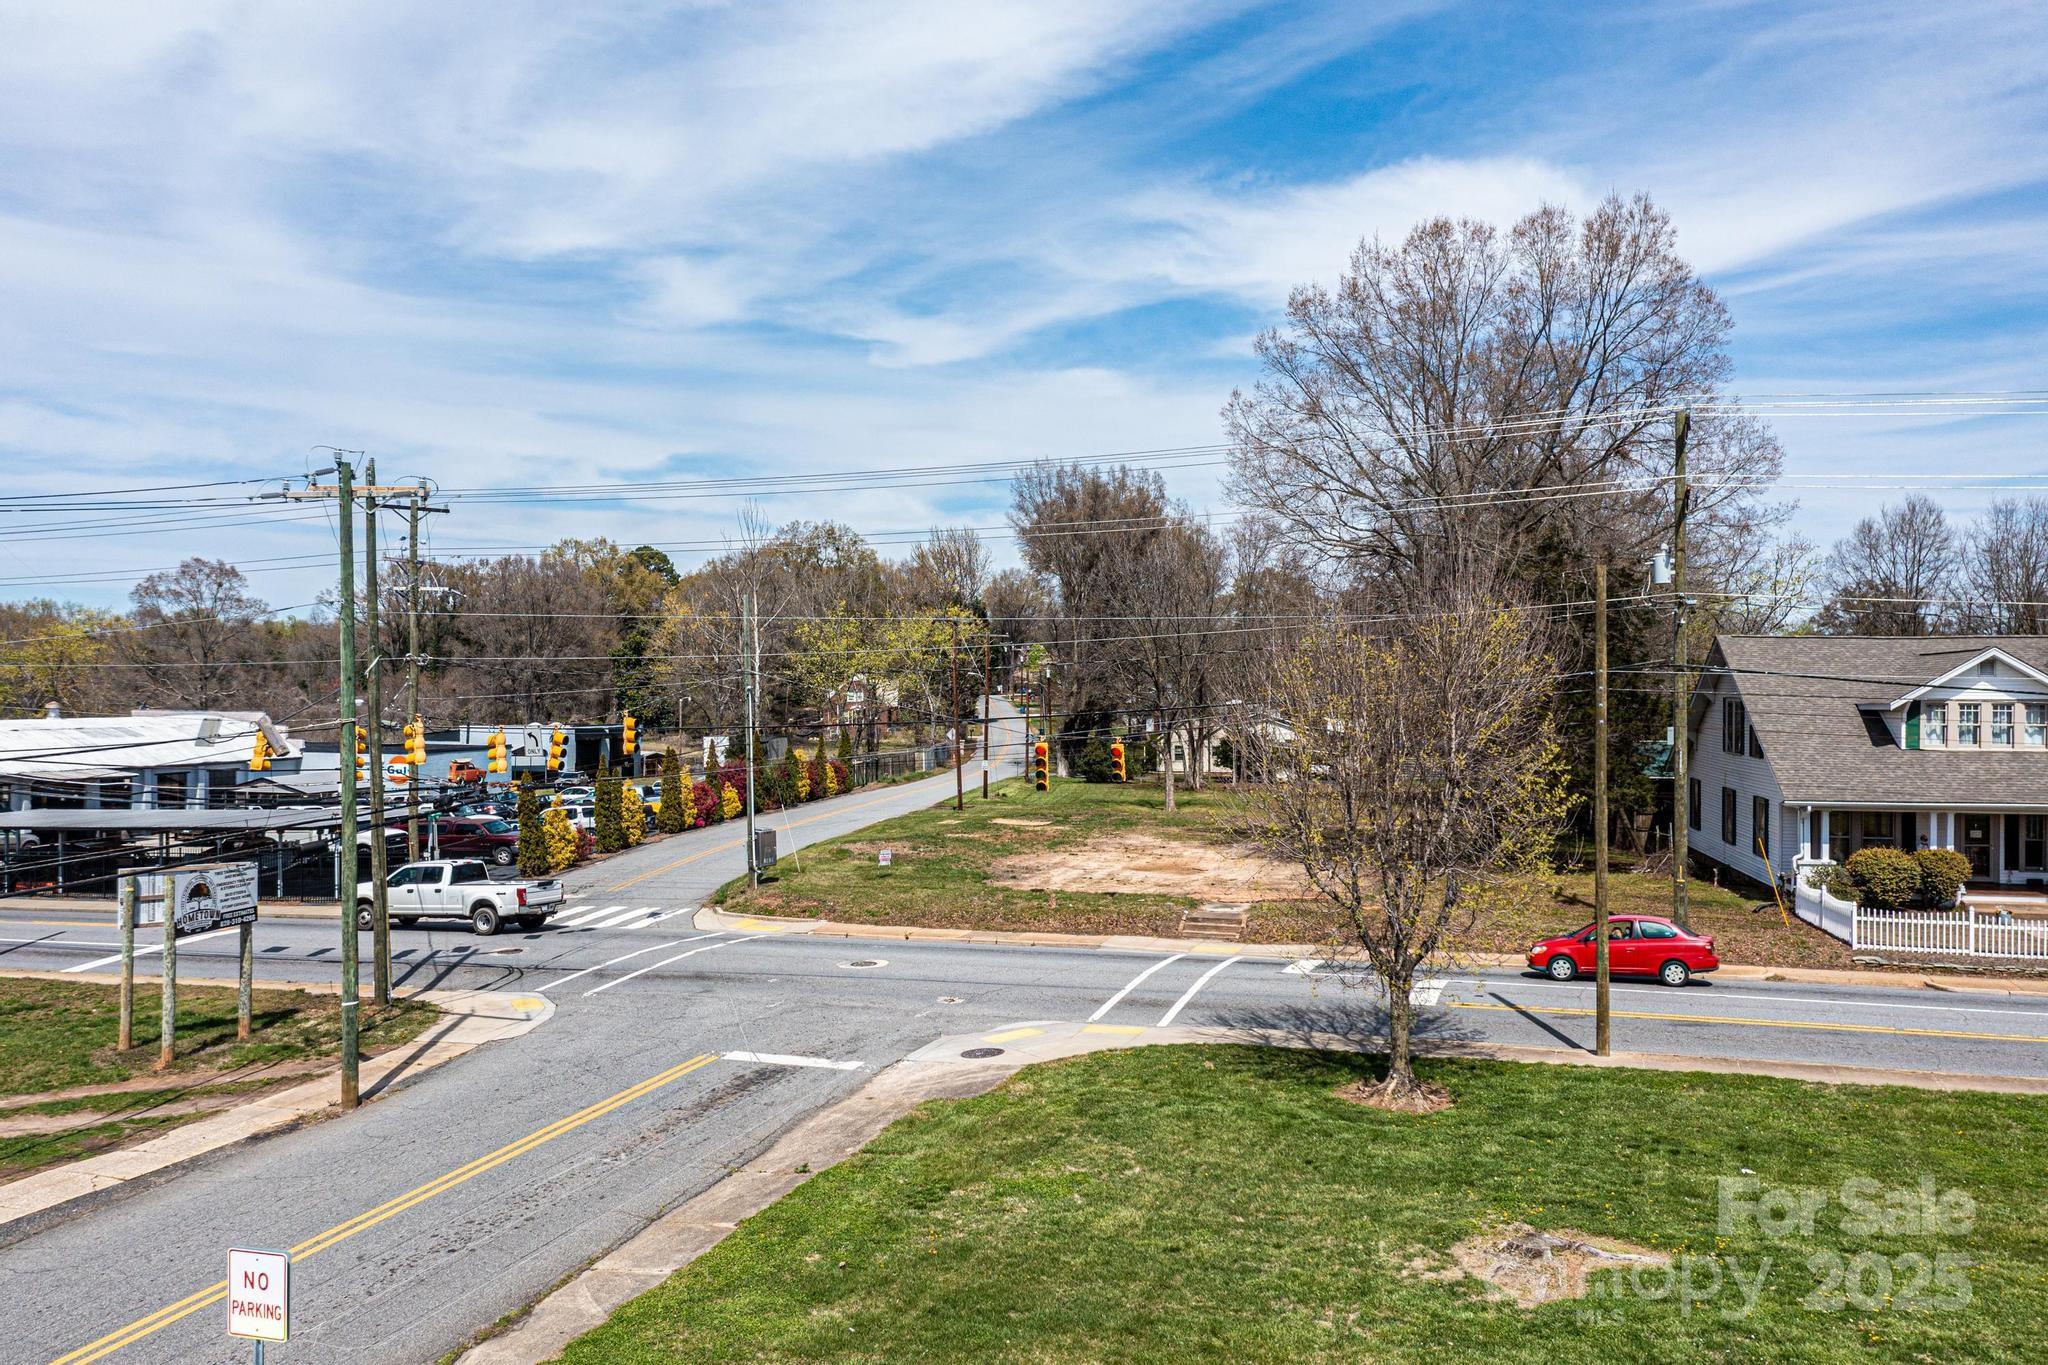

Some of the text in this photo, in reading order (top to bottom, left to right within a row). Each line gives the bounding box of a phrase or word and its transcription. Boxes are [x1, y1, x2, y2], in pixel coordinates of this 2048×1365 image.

[387, 765, 409, 775] Gul
[176, 910, 220, 927] HOMETOWN
[244, 1271, 269, 1291] NO
[232, 1300, 281, 1320] PARKING
